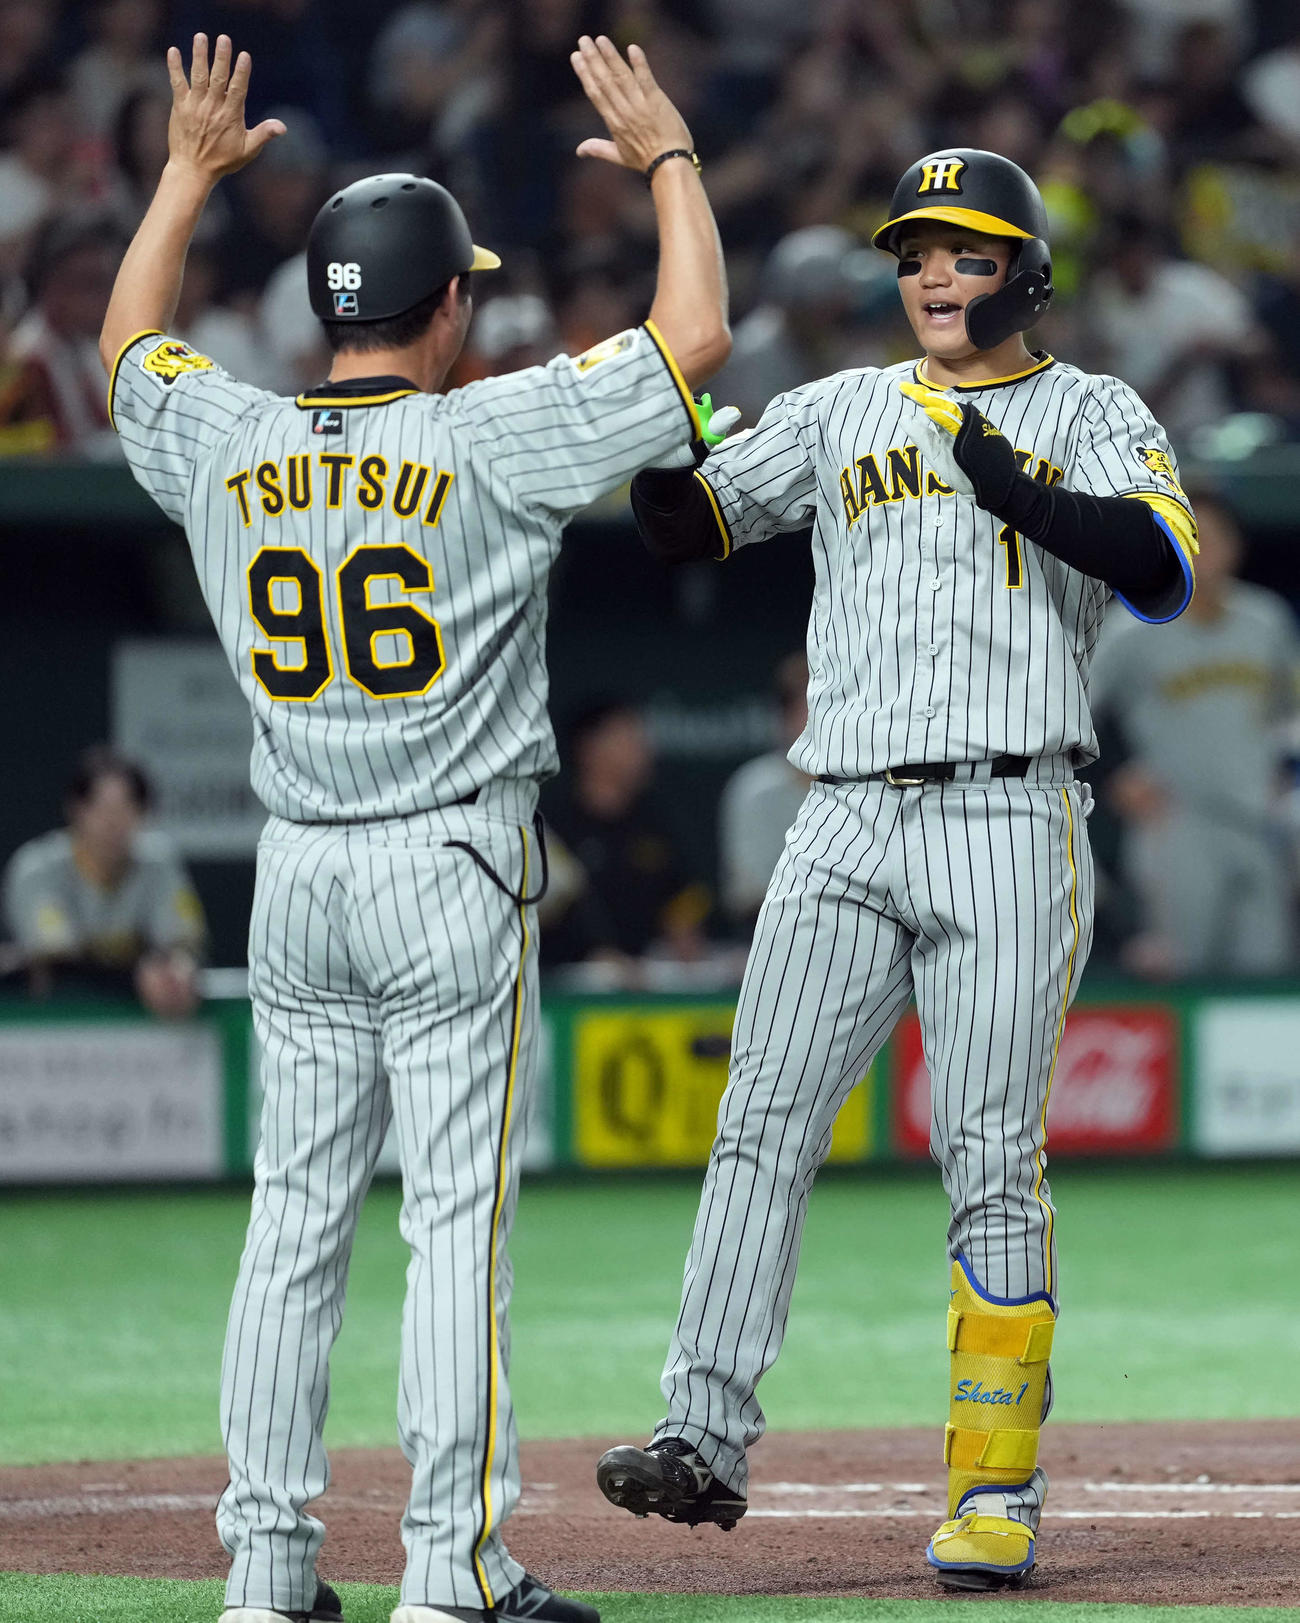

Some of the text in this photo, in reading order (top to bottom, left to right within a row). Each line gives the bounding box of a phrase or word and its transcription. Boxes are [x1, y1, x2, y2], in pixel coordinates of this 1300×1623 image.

[327, 262, 362, 291] 96
[225, 452, 455, 528] TSUTSUI
[998, 524, 1023, 589] 1
[246, 542, 447, 702] 96
